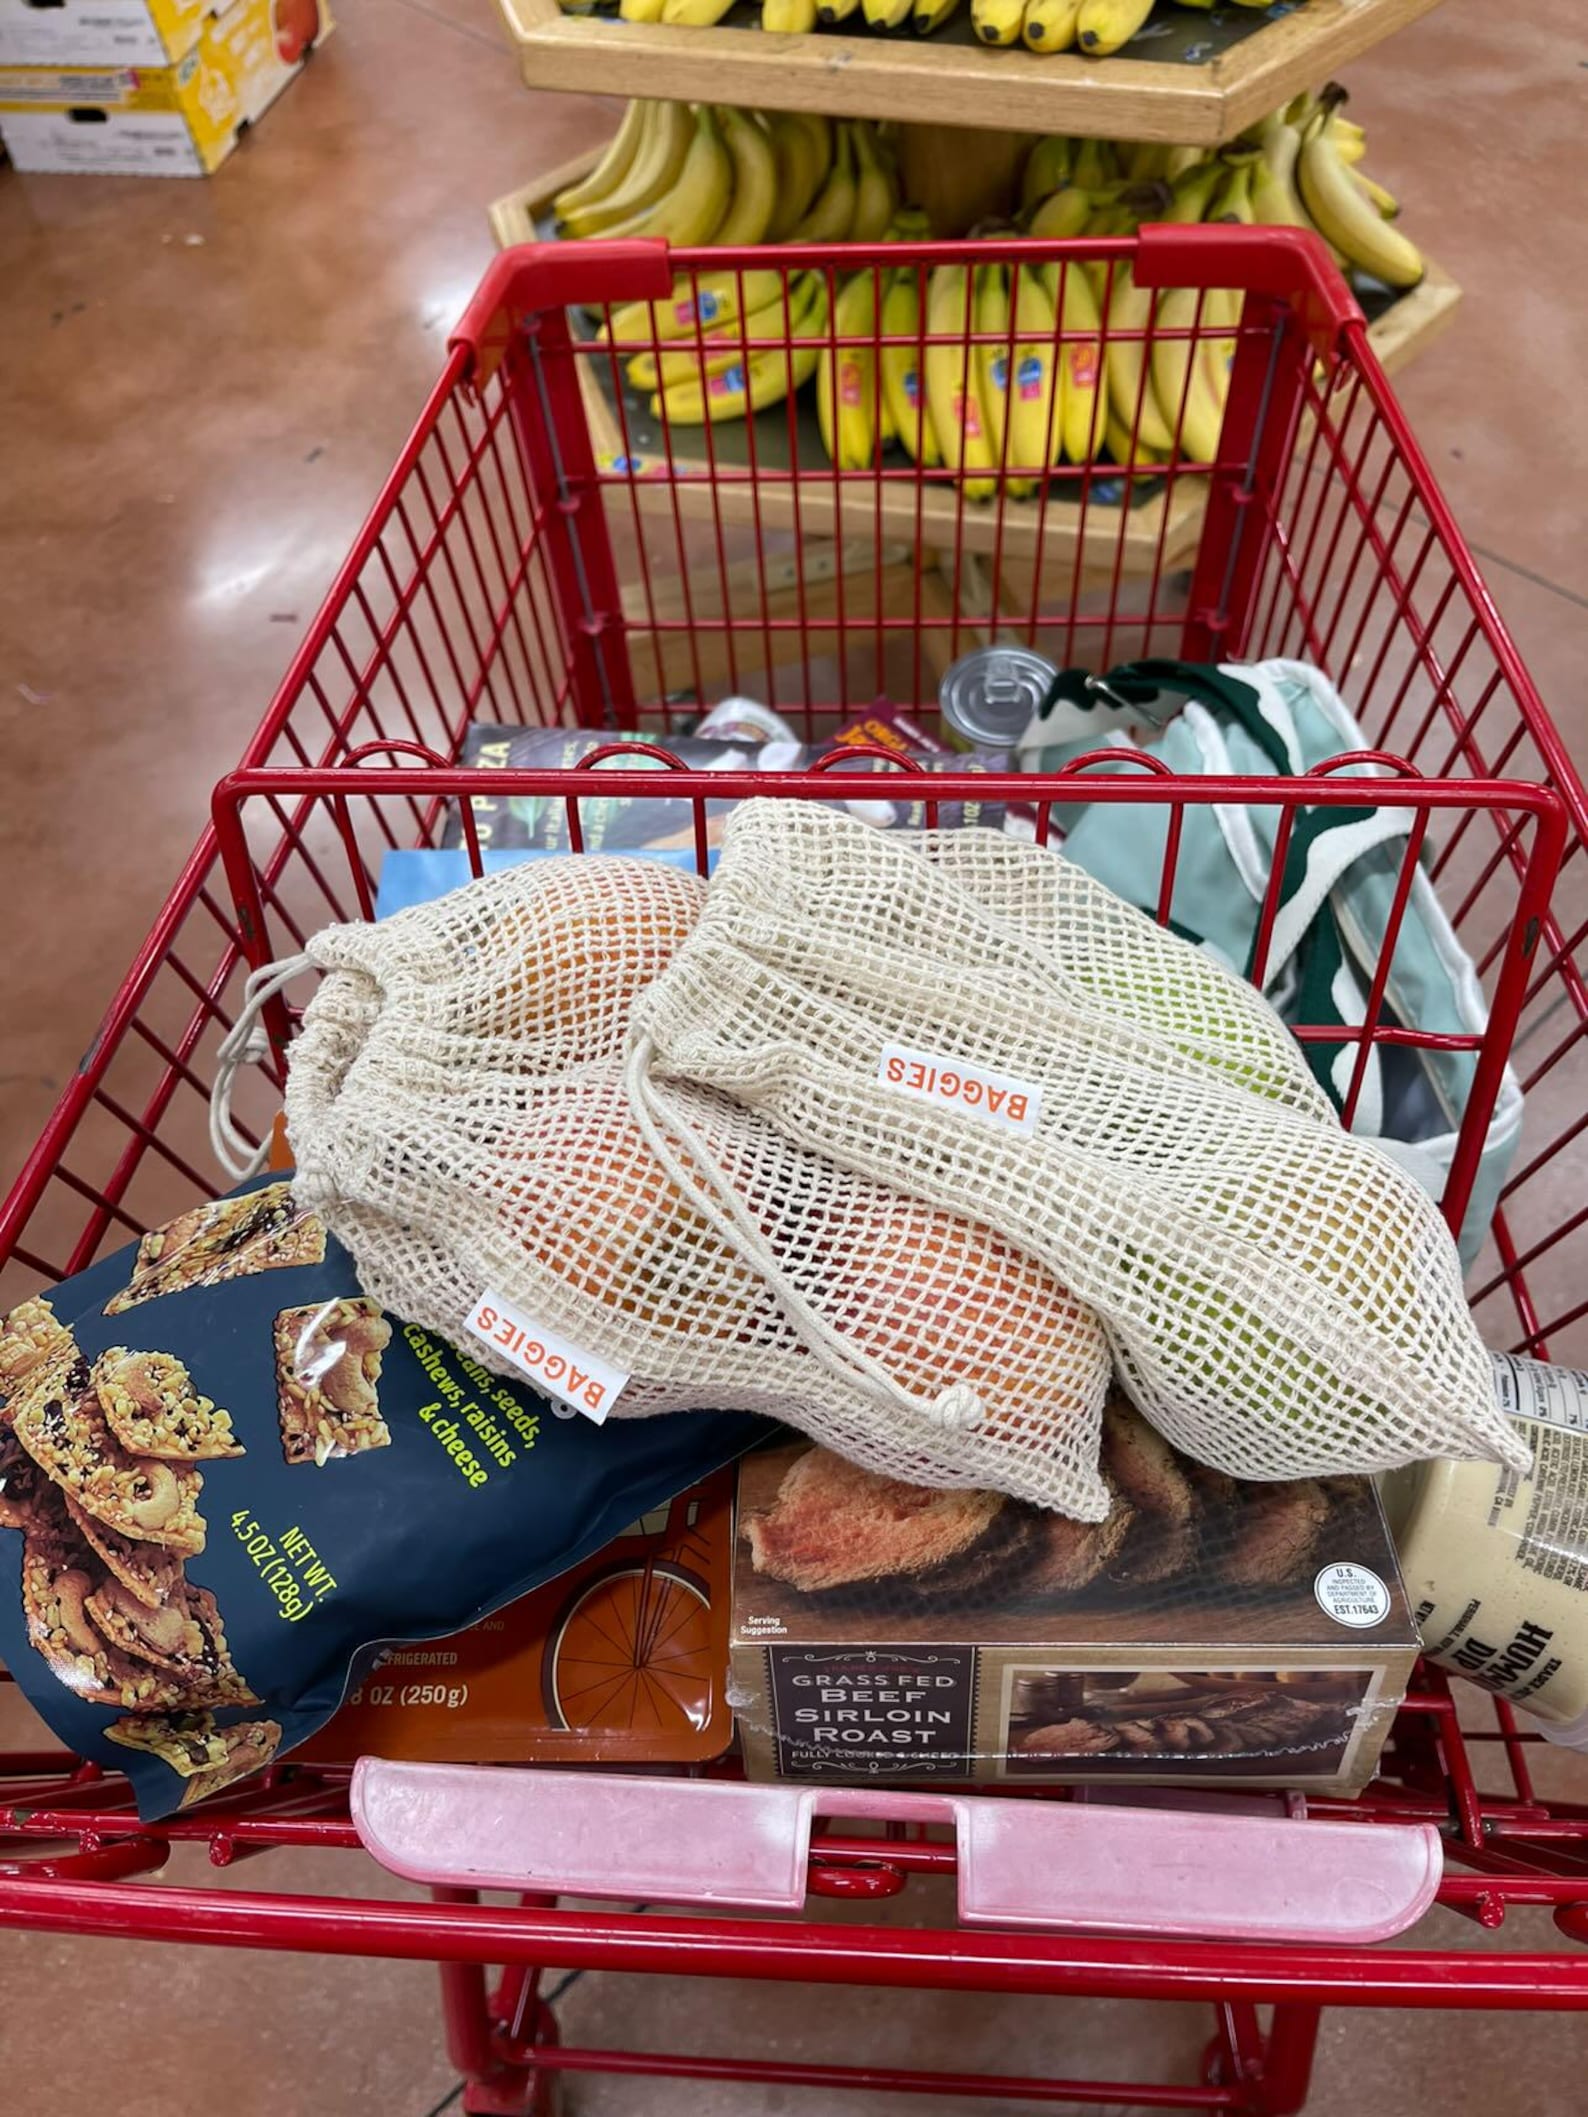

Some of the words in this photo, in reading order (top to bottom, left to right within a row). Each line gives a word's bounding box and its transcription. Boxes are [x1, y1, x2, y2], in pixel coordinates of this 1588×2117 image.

[887, 1057, 1028, 1121] BAGGIES
[477, 1306, 607, 1409] BAGGIES
[403, 1323, 465, 1408] cashews,
[460, 1402, 517, 1468] raisins
[490, 1389, 540, 1449] seeds,
[418, 1402, 442, 1422] &
[431, 1418, 489, 1488] cheese
[231, 1509, 260, 1541] 4.5
[246, 1534, 277, 1567] OZ
[279, 1526, 317, 1567] NET
[303, 1559, 338, 1603] WT.
[1335, 1568, 1357, 1578] U.S.
[260, 1557, 314, 1622] (128g)
[740, 1626, 788, 1636] Suggestion
[748, 1616, 781, 1627] Serving
[1452, 1637, 1498, 1671] DIP
[370, 1686, 395, 1705] OZ
[791, 1674, 890, 1687] GRASS
[898, 1675, 956, 1688] FED
[820, 1688, 927, 1704] BEEF
[794, 1708, 951, 1724] SIRLOIN
[813, 1726, 937, 1744] ROAST
